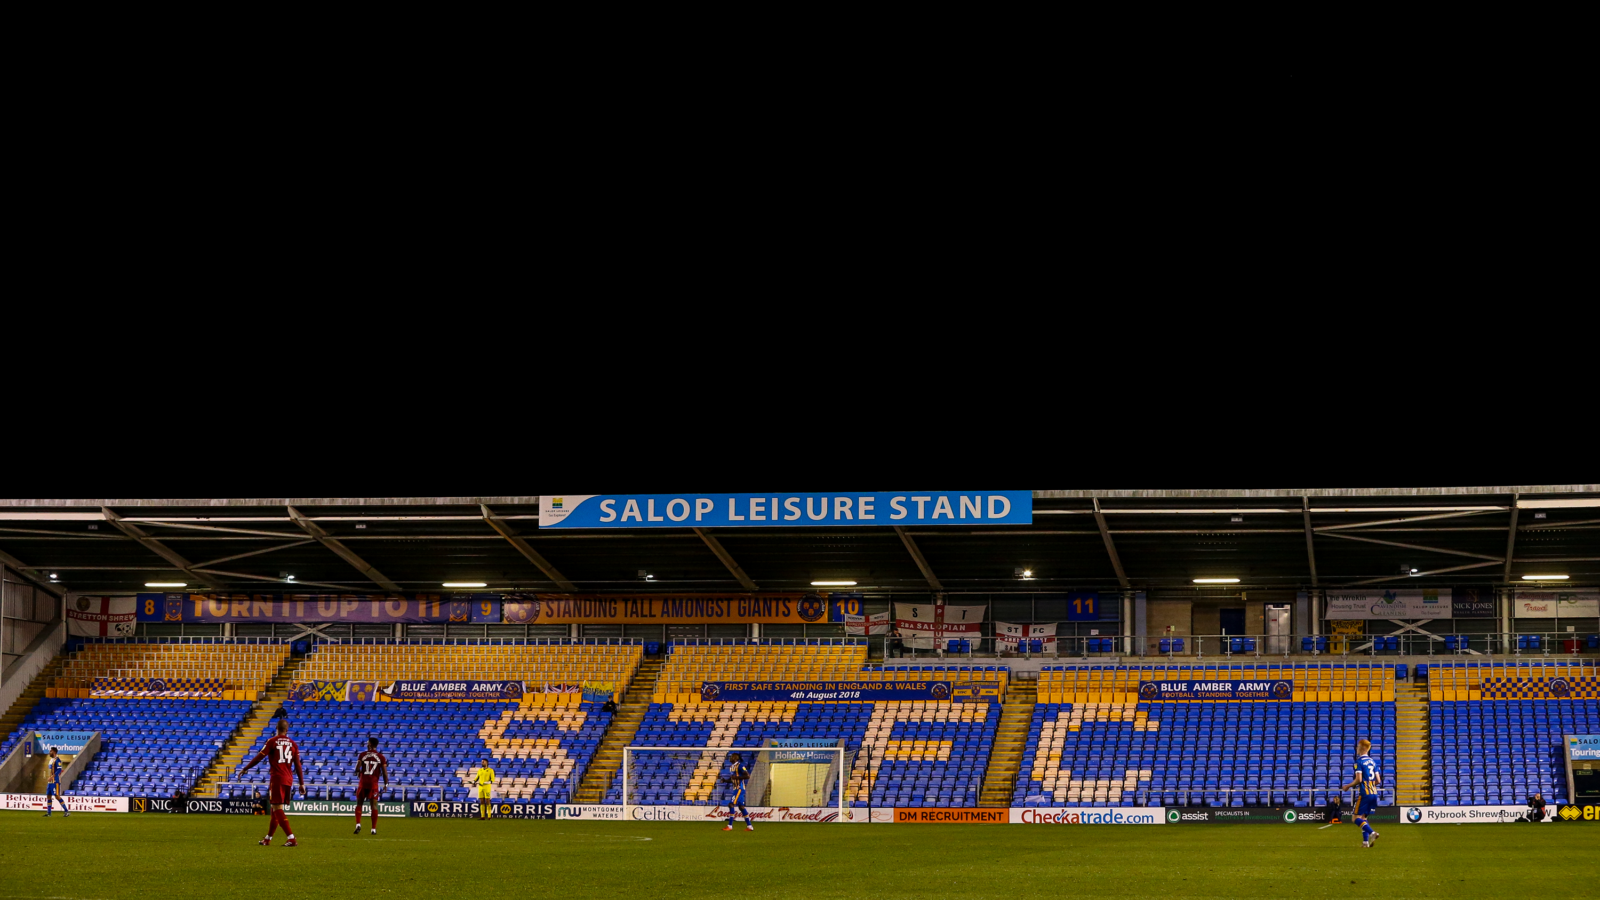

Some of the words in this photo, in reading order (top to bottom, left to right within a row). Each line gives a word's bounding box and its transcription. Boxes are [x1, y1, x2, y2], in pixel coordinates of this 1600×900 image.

[599, 497, 715, 523] SALOP
[728, 495, 876, 521] LEISURE
[889, 494, 1012, 520] STAND
[144, 599, 155, 615] 8
[190, 594, 273, 618] TURN
[281, 594, 310, 617] IT
[317, 594, 359, 617] UP
[370, 594, 408, 617] TO
[481, 600, 492, 616] 9
[545, 598, 618, 618] STANDING
[622, 598, 656, 618] TALL
[660, 597, 733, 618] AMONGST
[737, 597, 791, 618] GIANTS
[836, 598, 859, 615] 10
[1073, 598, 1094, 613] 11
[1472, 602, 1493, 610] JONES
[69, 611, 107, 620] STRETTON
[917, 623, 966, 631] SALOPIAN
[400, 683, 426, 691] BLUE
[430, 683, 467, 691] AMBER
[471, 683, 503, 691] ARMY
[724, 683, 749, 691] FIRST
[1160, 683, 1188, 692] BLUE
[1193, 683, 1232, 691] AMBER
[1238, 682, 1271, 691] ARMY
[790, 691, 805, 699] 4th
[806, 691, 837, 700] August
[276, 745, 293, 764] 14
[775, 751, 805, 760] Holiday
[806, 751, 834, 759] Homes
[1570, 748, 1600, 757] Touring
[364, 760, 380, 775] 17
[1367, 765, 1375, 780] 3
[293, 802, 329, 811] Wrekin
[378, 803, 405, 812] Trust
[413, 803, 480, 812] MORRIS
[632, 807, 676, 820] Celtic
[778, 807, 822, 821] Travel
[899, 812, 917, 820] DM
[921, 812, 1004, 821] RECRUITMENT
[1021, 808, 1154, 824] Checkatrade.com
[1182, 811, 1208, 820] assist
[1298, 811, 1325, 820] assist
[1427, 810, 1466, 820] Rybrook
